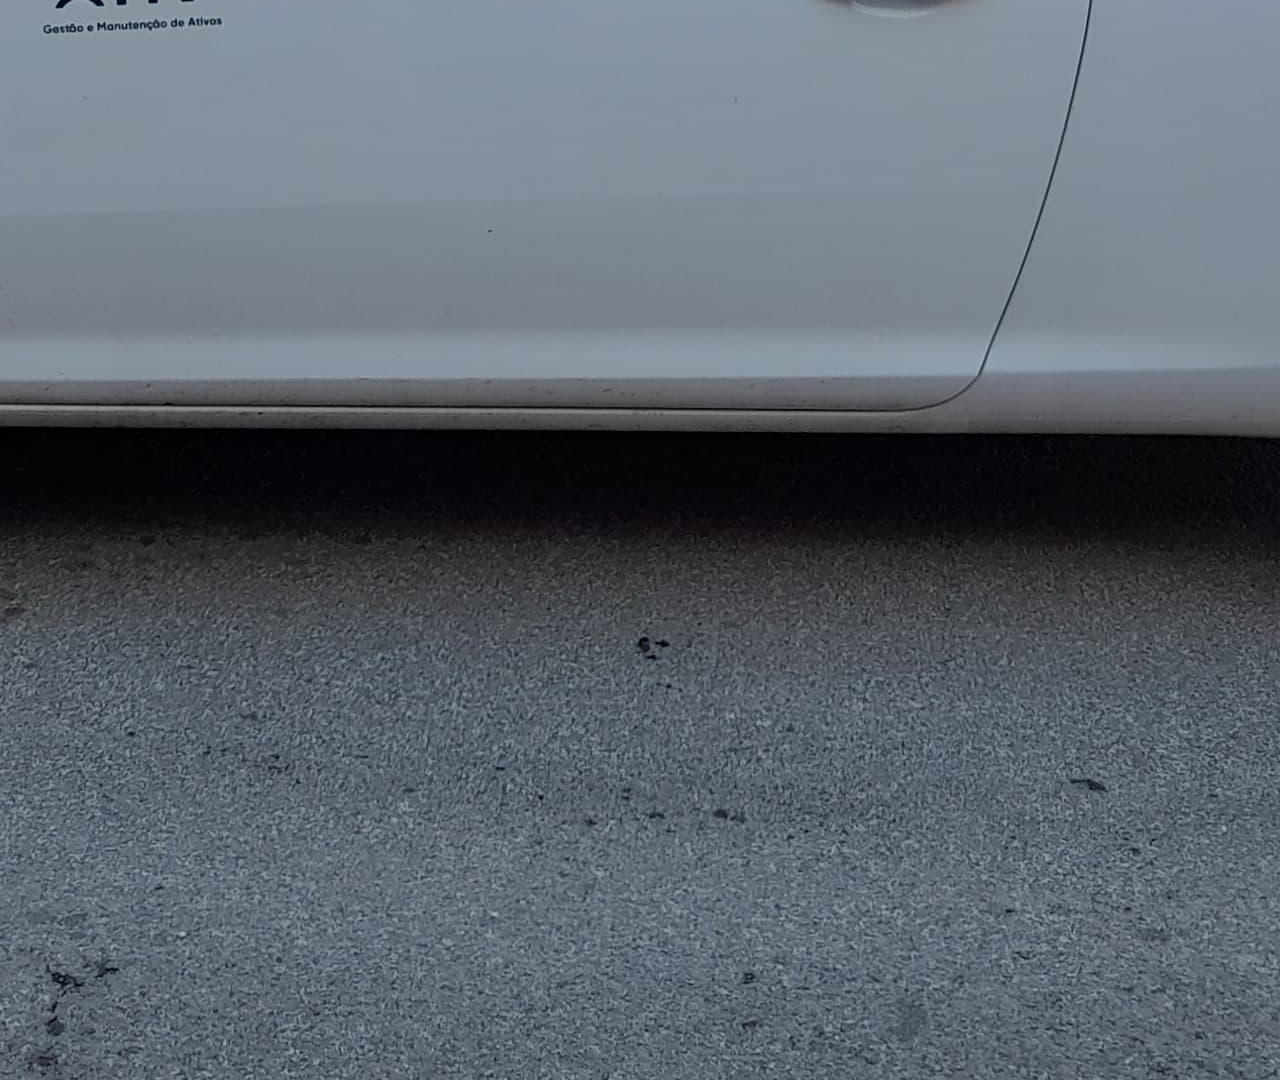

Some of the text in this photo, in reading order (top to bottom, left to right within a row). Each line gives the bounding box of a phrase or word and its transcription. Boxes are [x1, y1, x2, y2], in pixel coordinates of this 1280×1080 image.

[43, 16, 223, 35] Gestão e Manutenção de Ativos
